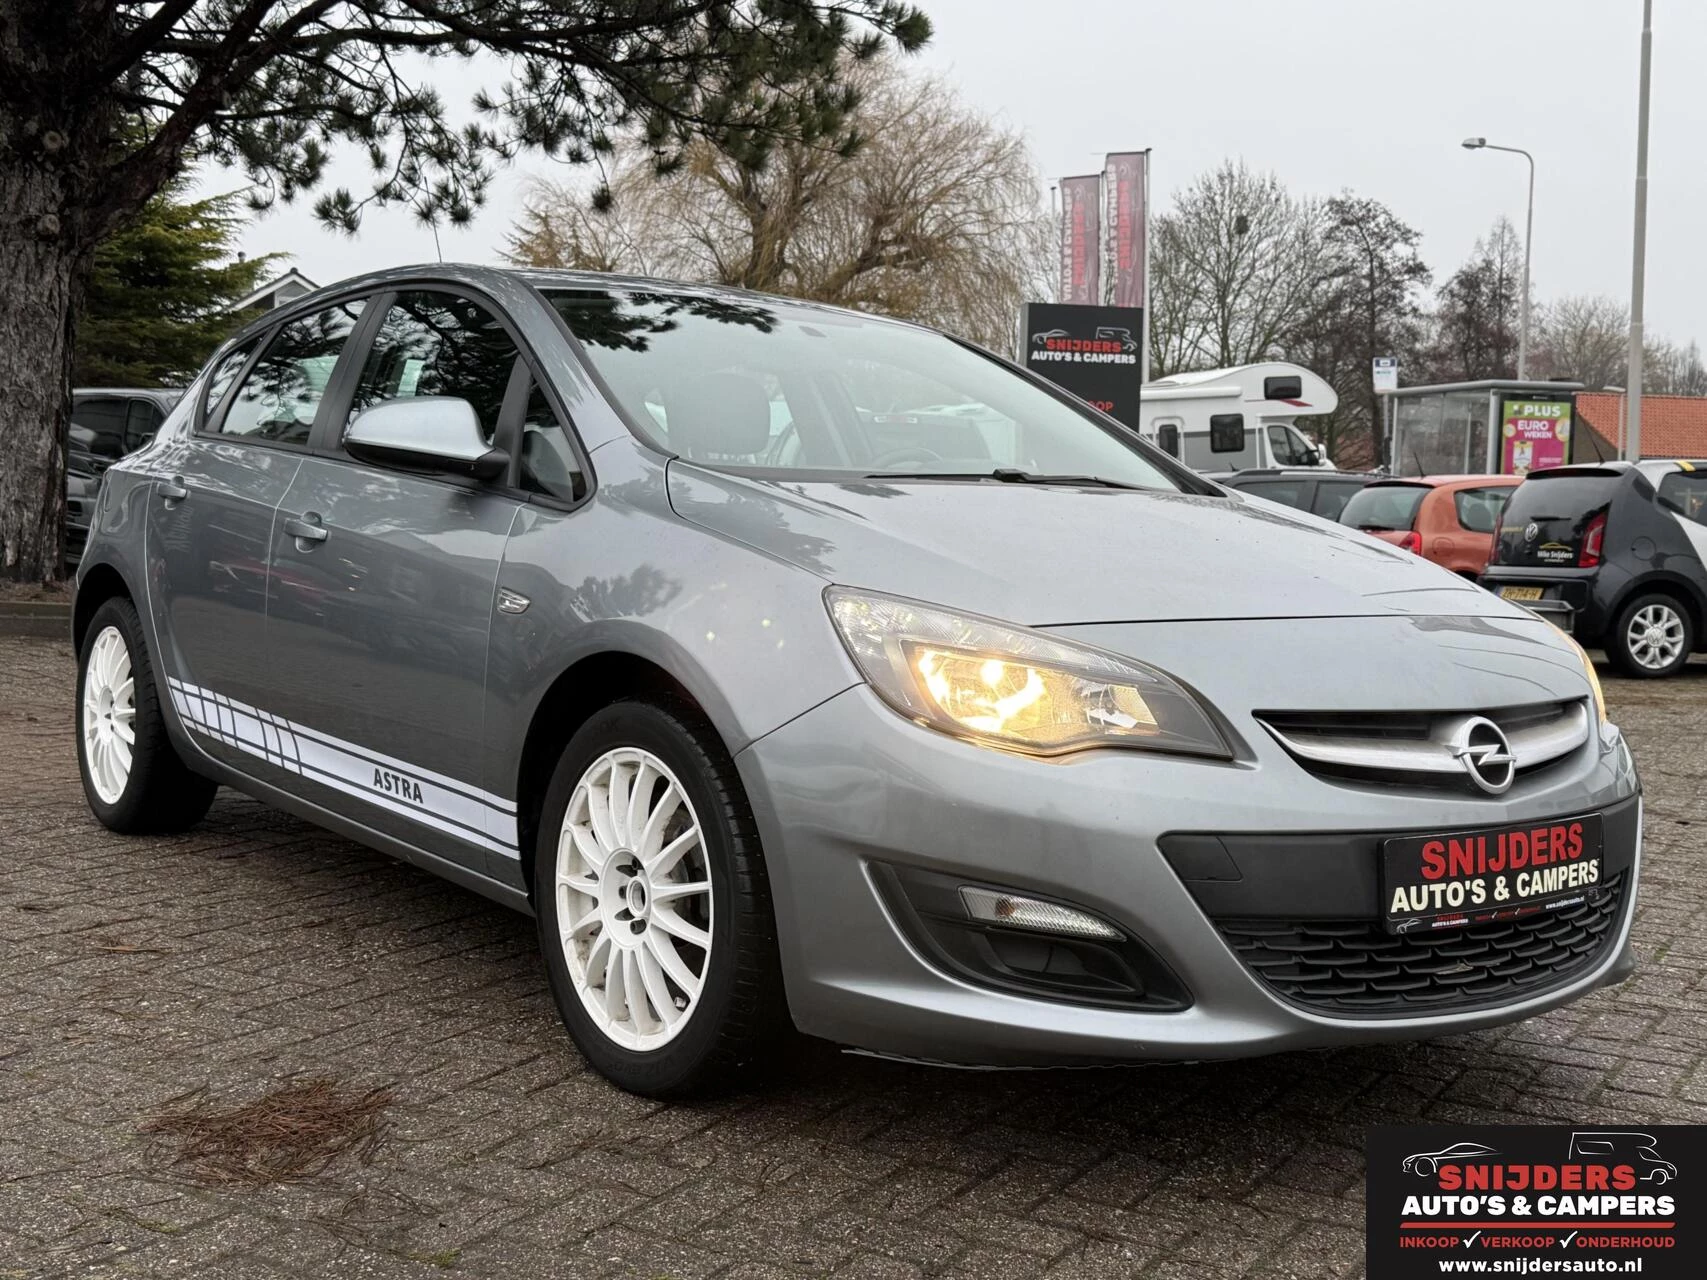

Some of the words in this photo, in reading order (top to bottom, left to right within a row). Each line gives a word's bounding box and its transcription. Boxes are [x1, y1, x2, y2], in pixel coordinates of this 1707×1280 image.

[1046, 338, 1122, 353] SNIJDERS
[1031, 351, 1072, 361] AUTO'S
[1074, 352, 1082, 362] &
[1083, 353, 1136, 364] CAMPERS
[1524, 405, 1561, 416] PLUS
[1518, 420, 1549, 431] EURO
[1524, 431, 1552, 439] WEKEN
[373, 767, 424, 804] ASTRA
[1421, 822, 1583, 880] SNIJDERS
[1390, 878, 1486, 913] AUTO'S
[1493, 876, 1510, 901] &
[1516, 860, 1599, 898] CAMPERS
